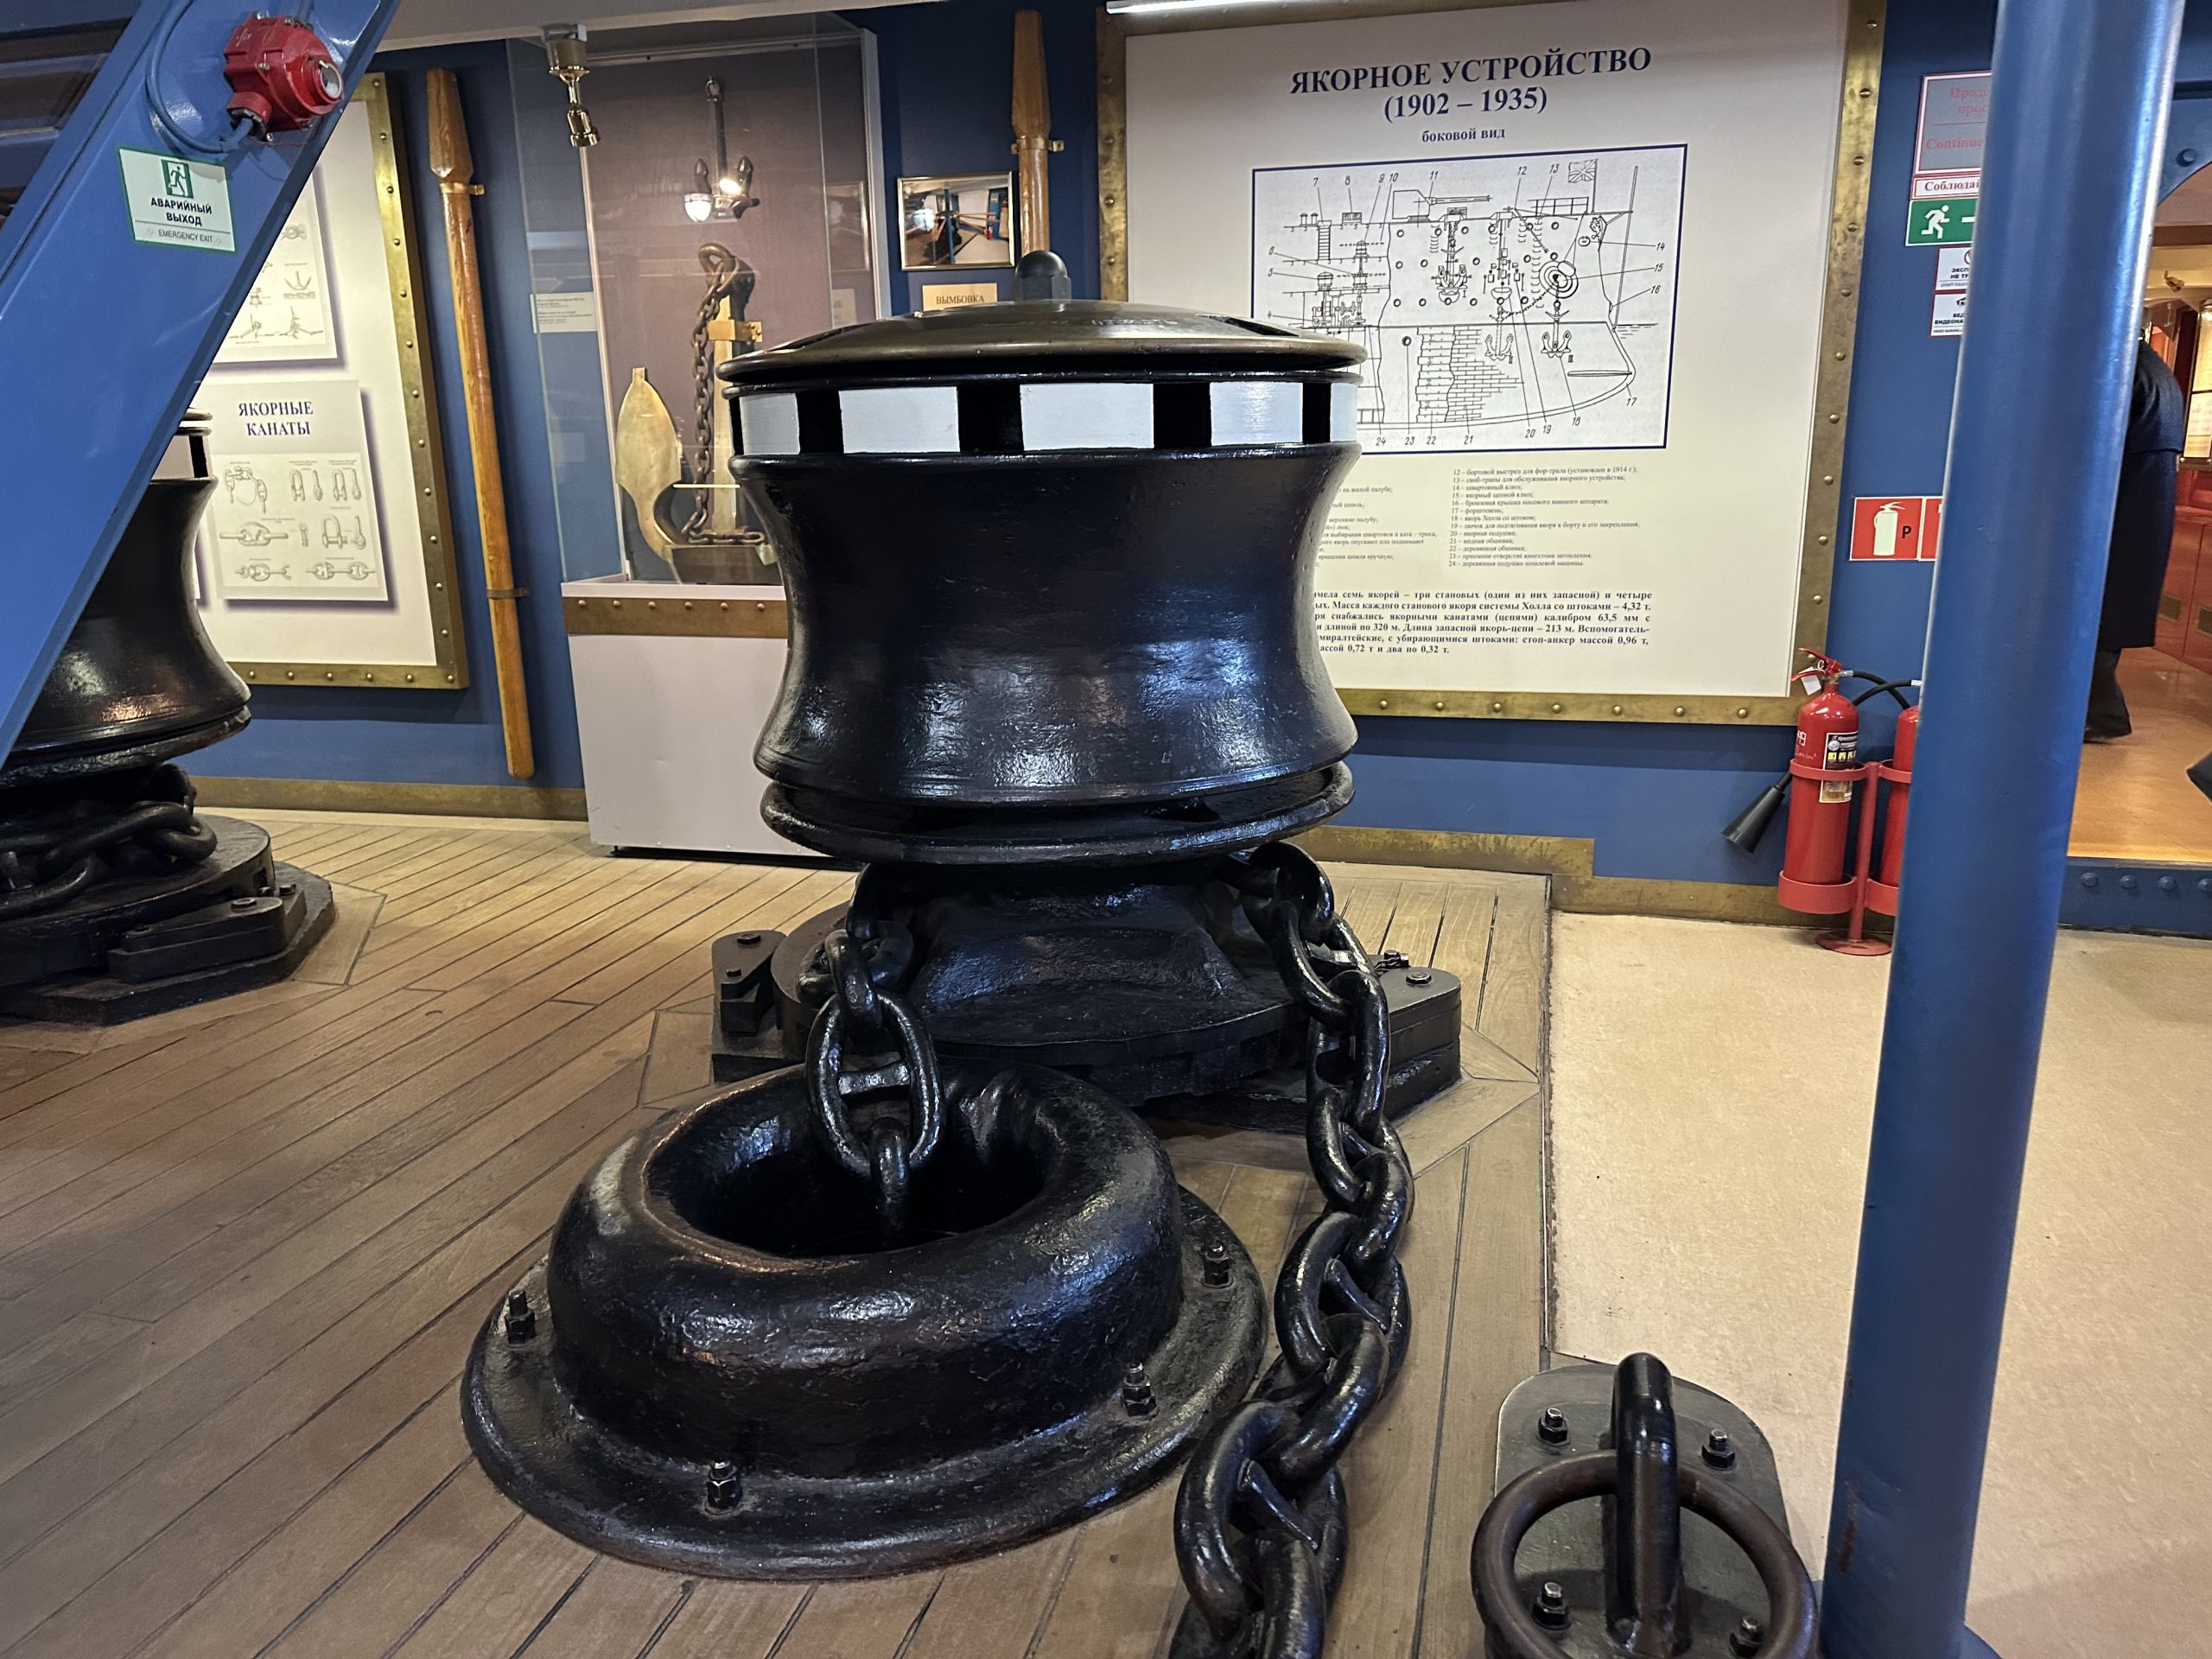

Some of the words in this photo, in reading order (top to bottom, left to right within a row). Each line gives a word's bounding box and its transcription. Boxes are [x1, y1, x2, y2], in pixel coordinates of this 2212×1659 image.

[1290, 63, 1431, 94] ЯКОРНОЕ
[1441, 48, 1652, 84] УСТРОЙСТВО
[1384, 92, 1449, 123] (1902
[1481, 86, 1548, 114] 1935)
[1421, 128, 1477, 143] боковой
[1481, 128, 1505, 139] вид
[1517, 166, 1528, 175] 12
[1549, 163, 1560, 174] 13
[1345, 175, 1351, 185] 8
[1379, 173, 1385, 183] 9
[1389, 172, 1399, 182] 10
[1430, 170, 1439, 180] 11
[1313, 177, 1319, 187] 7
[150, 197, 213, 214] АВАРИЙНЫЙ
[166, 213, 202, 226] ВЫХОД
[158, 229, 199, 241] EMERGENCY
[1656, 242, 1665, 251] 14
[1654, 264, 1664, 272] 15
[1650, 285, 1661, 294] 16
[936, 295, 985, 304] ВЫМБОВКА
[1626, 397, 1637, 406] 17
[238, 401, 314, 416] ЯКОРНЫЕ
[1572, 416, 1580, 426] 18
[246, 421, 311, 436] КАНАТЫ
[1525, 429, 1535, 438] 20
[1543, 424, 1552, 434] 19
[1376, 437, 1386, 446] 24
[1405, 436, 1414, 446] 23
[1426, 435, 1436, 445] 22
[1464, 435, 1473, 444] 21
[1368, 590, 1399, 601] якорей
[1414, 592, 1430, 601] три
[1484, 590, 1510, 600] (один
[1554, 591, 1599, 600] запасной)
[1616, 592, 1651, 601] четыре
[1332, 601, 1359, 609] Масса
[1449, 603, 1476, 612] якоря
[1522, 601, 1551, 610] Холла
[1622, 601, 1641, 612] 4,32
[1314, 613, 1325, 622] ря
[1331, 612, 1383, 620] снабжались
[1389, 613, 1437, 622] якорными
[1495, 613, 1537, 622] (цепями)
[1544, 613, 1591, 623] калибром
[1598, 613, 1617, 623] 63,5
[1325, 623, 1357, 632] длиной
[1373, 623, 1388, 632] 320
[1402, 623, 1432, 632] Длина
[1479, 626, 1534, 634] якорь-цепи
[1545, 624, 1561, 632] 213
[1578, 624, 1649, 633] Вспомогатель-
[1319, 633, 1385, 644] миралтейские,
[1396, 634, 1467, 645] убирающимися
[1522, 637, 1574, 645] стоп-анкер
[1618, 636, 1637, 645] 0,96
[1320, 644, 1344, 652] ассой
[1347, 644, 1364, 653] 0,72
[1421, 645, 1438, 654] 0,32
